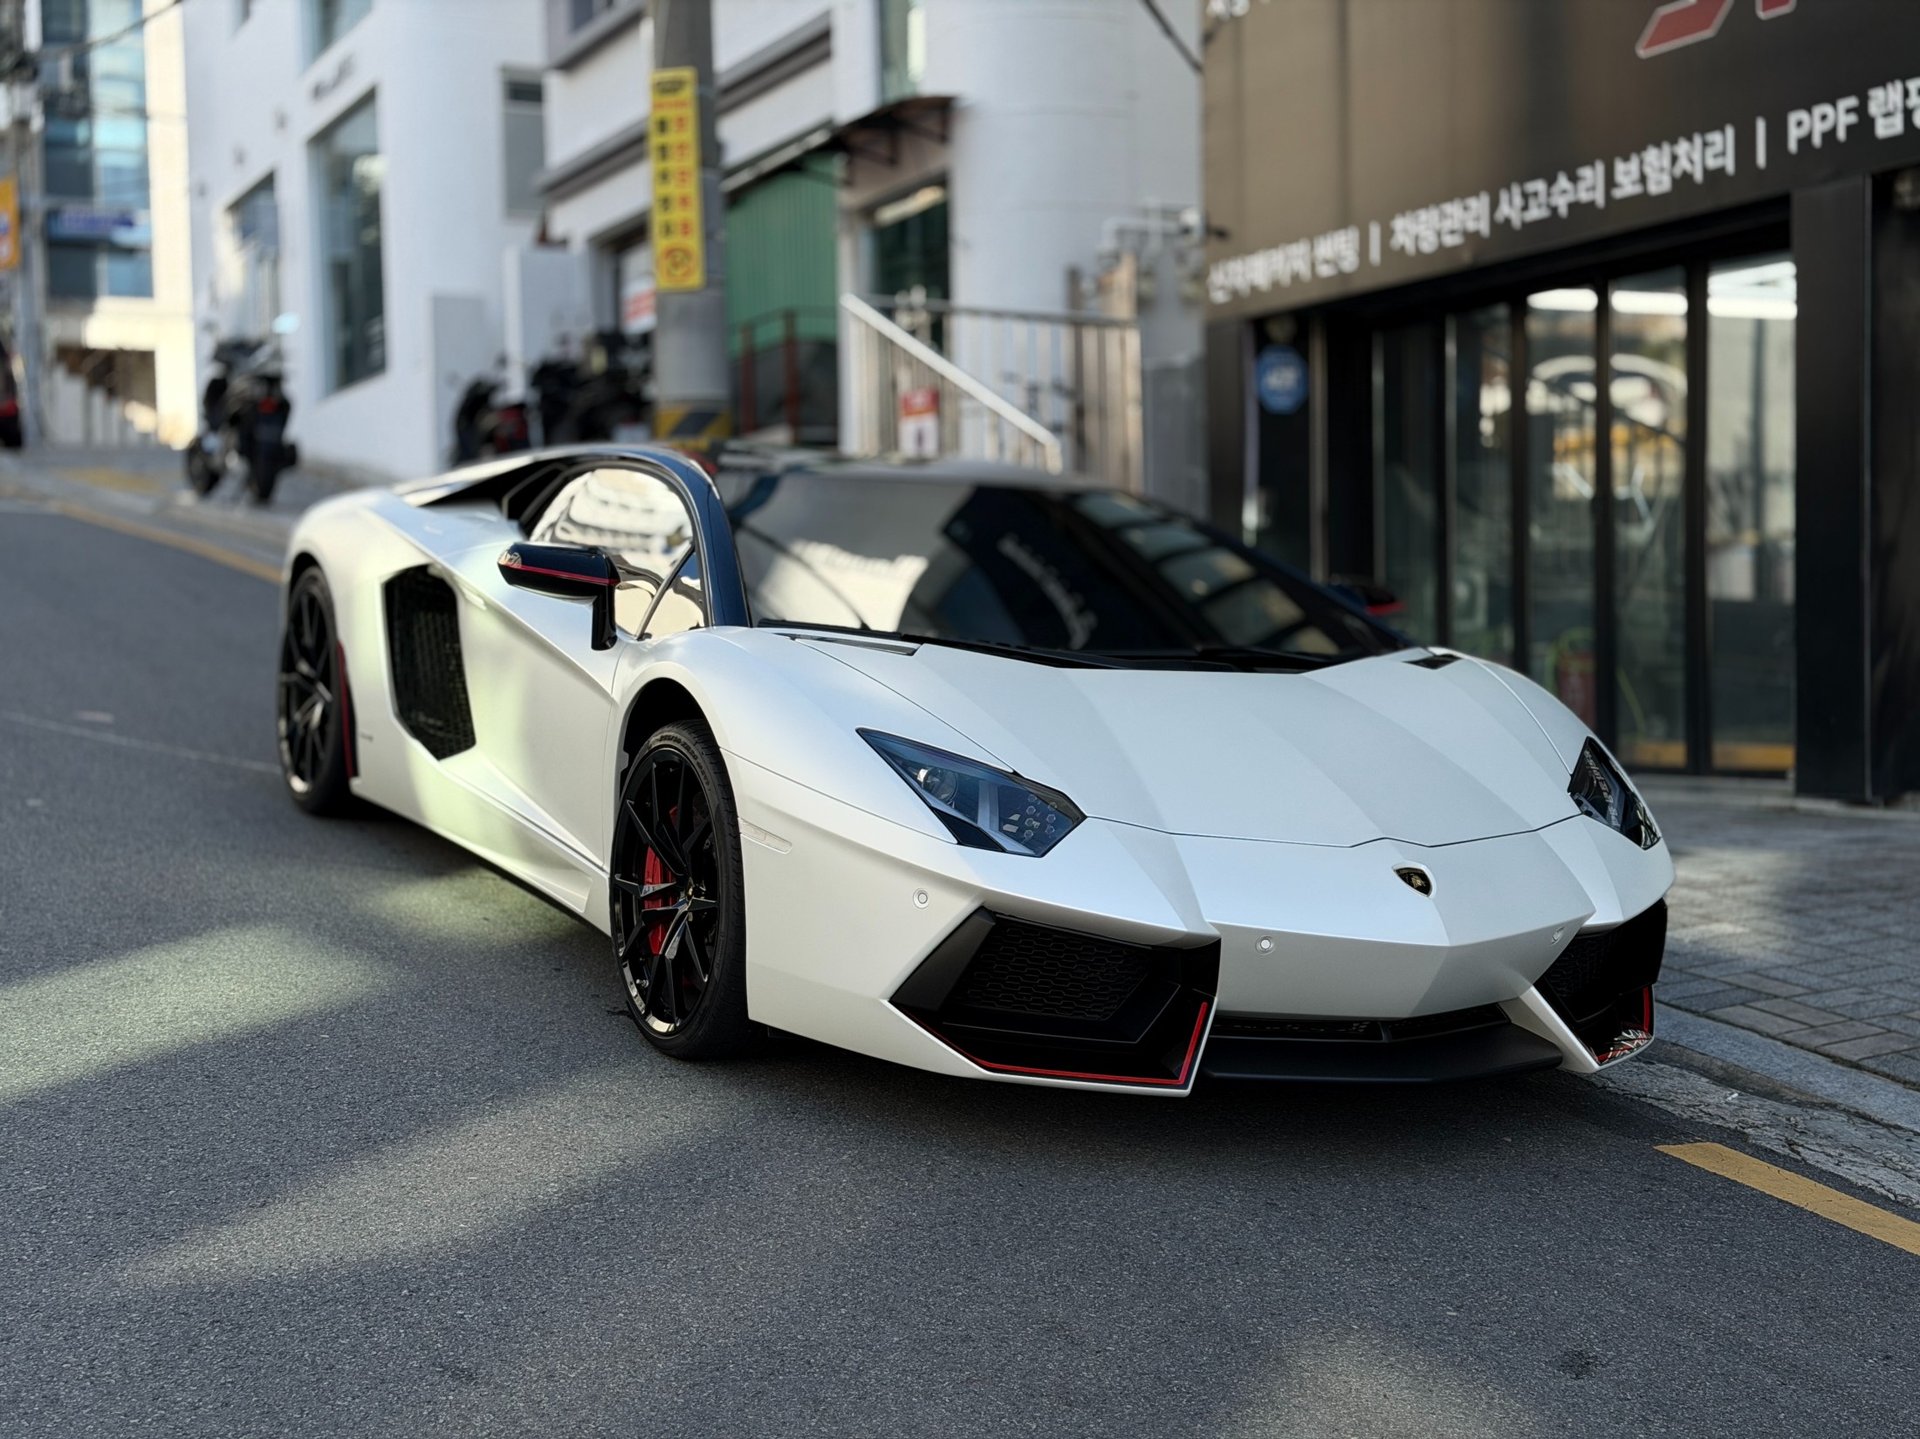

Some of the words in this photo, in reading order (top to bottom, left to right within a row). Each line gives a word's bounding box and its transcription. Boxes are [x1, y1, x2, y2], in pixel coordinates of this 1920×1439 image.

[1390, 190, 1491, 256] 차량관리
[1494, 158, 1605, 230] 사고수리
[1610, 123, 1735, 199] 보험처리
[1787, 95, 1860, 154] PPF
